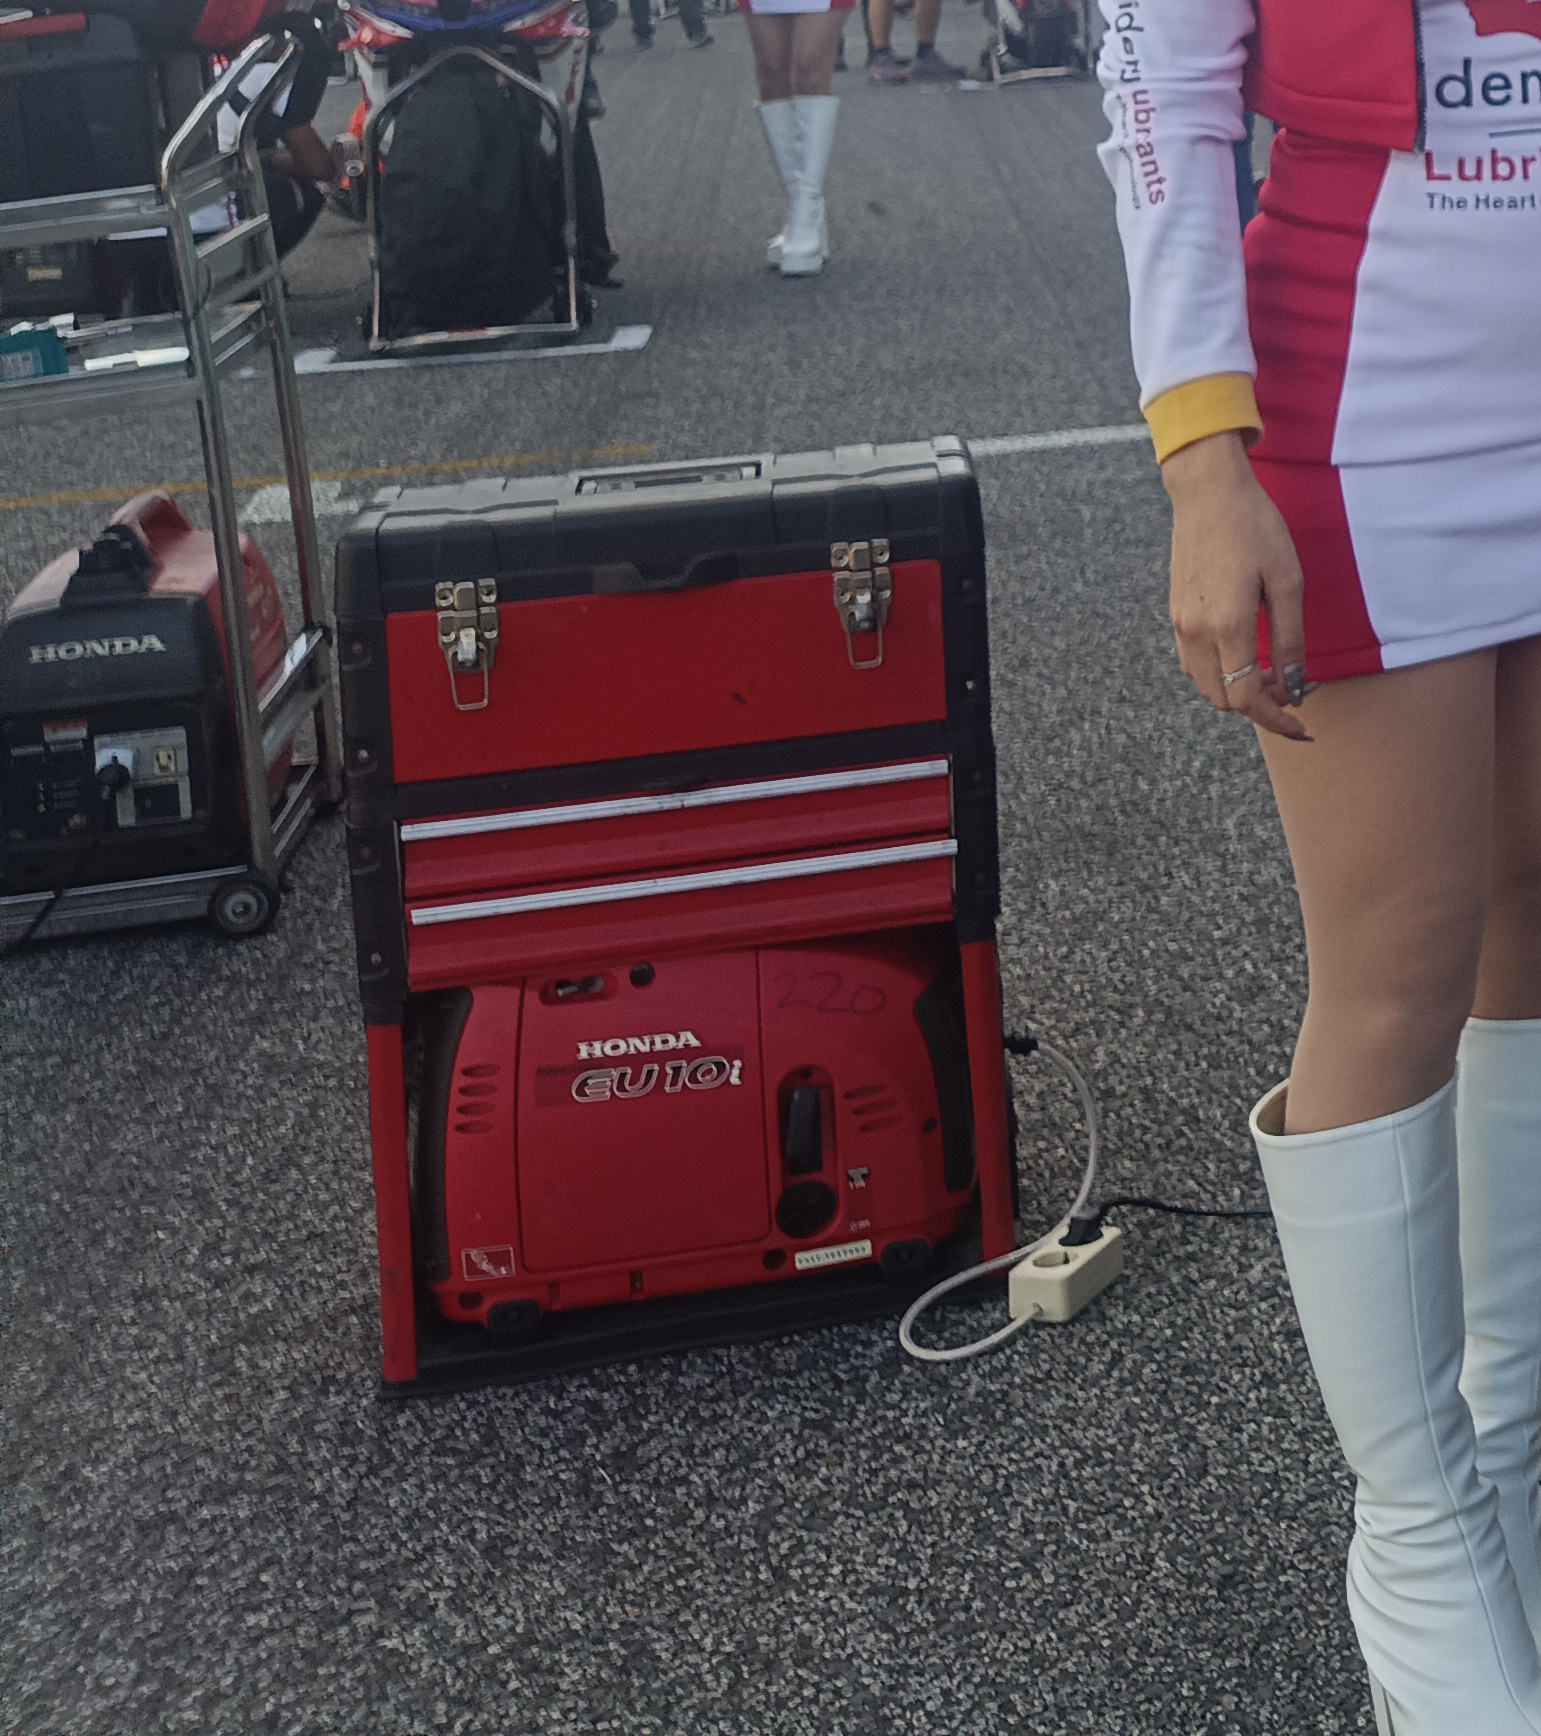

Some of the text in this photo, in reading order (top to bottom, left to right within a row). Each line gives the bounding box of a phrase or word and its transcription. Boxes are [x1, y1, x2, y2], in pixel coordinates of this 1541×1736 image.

[1426, 191, 1469, 211] The
[1474, 191, 1537, 211] Heart
[28, 634, 167, 664] HONDA
[773, 969, 888, 1015] 220
[576, 1030, 702, 1060] HONDA
